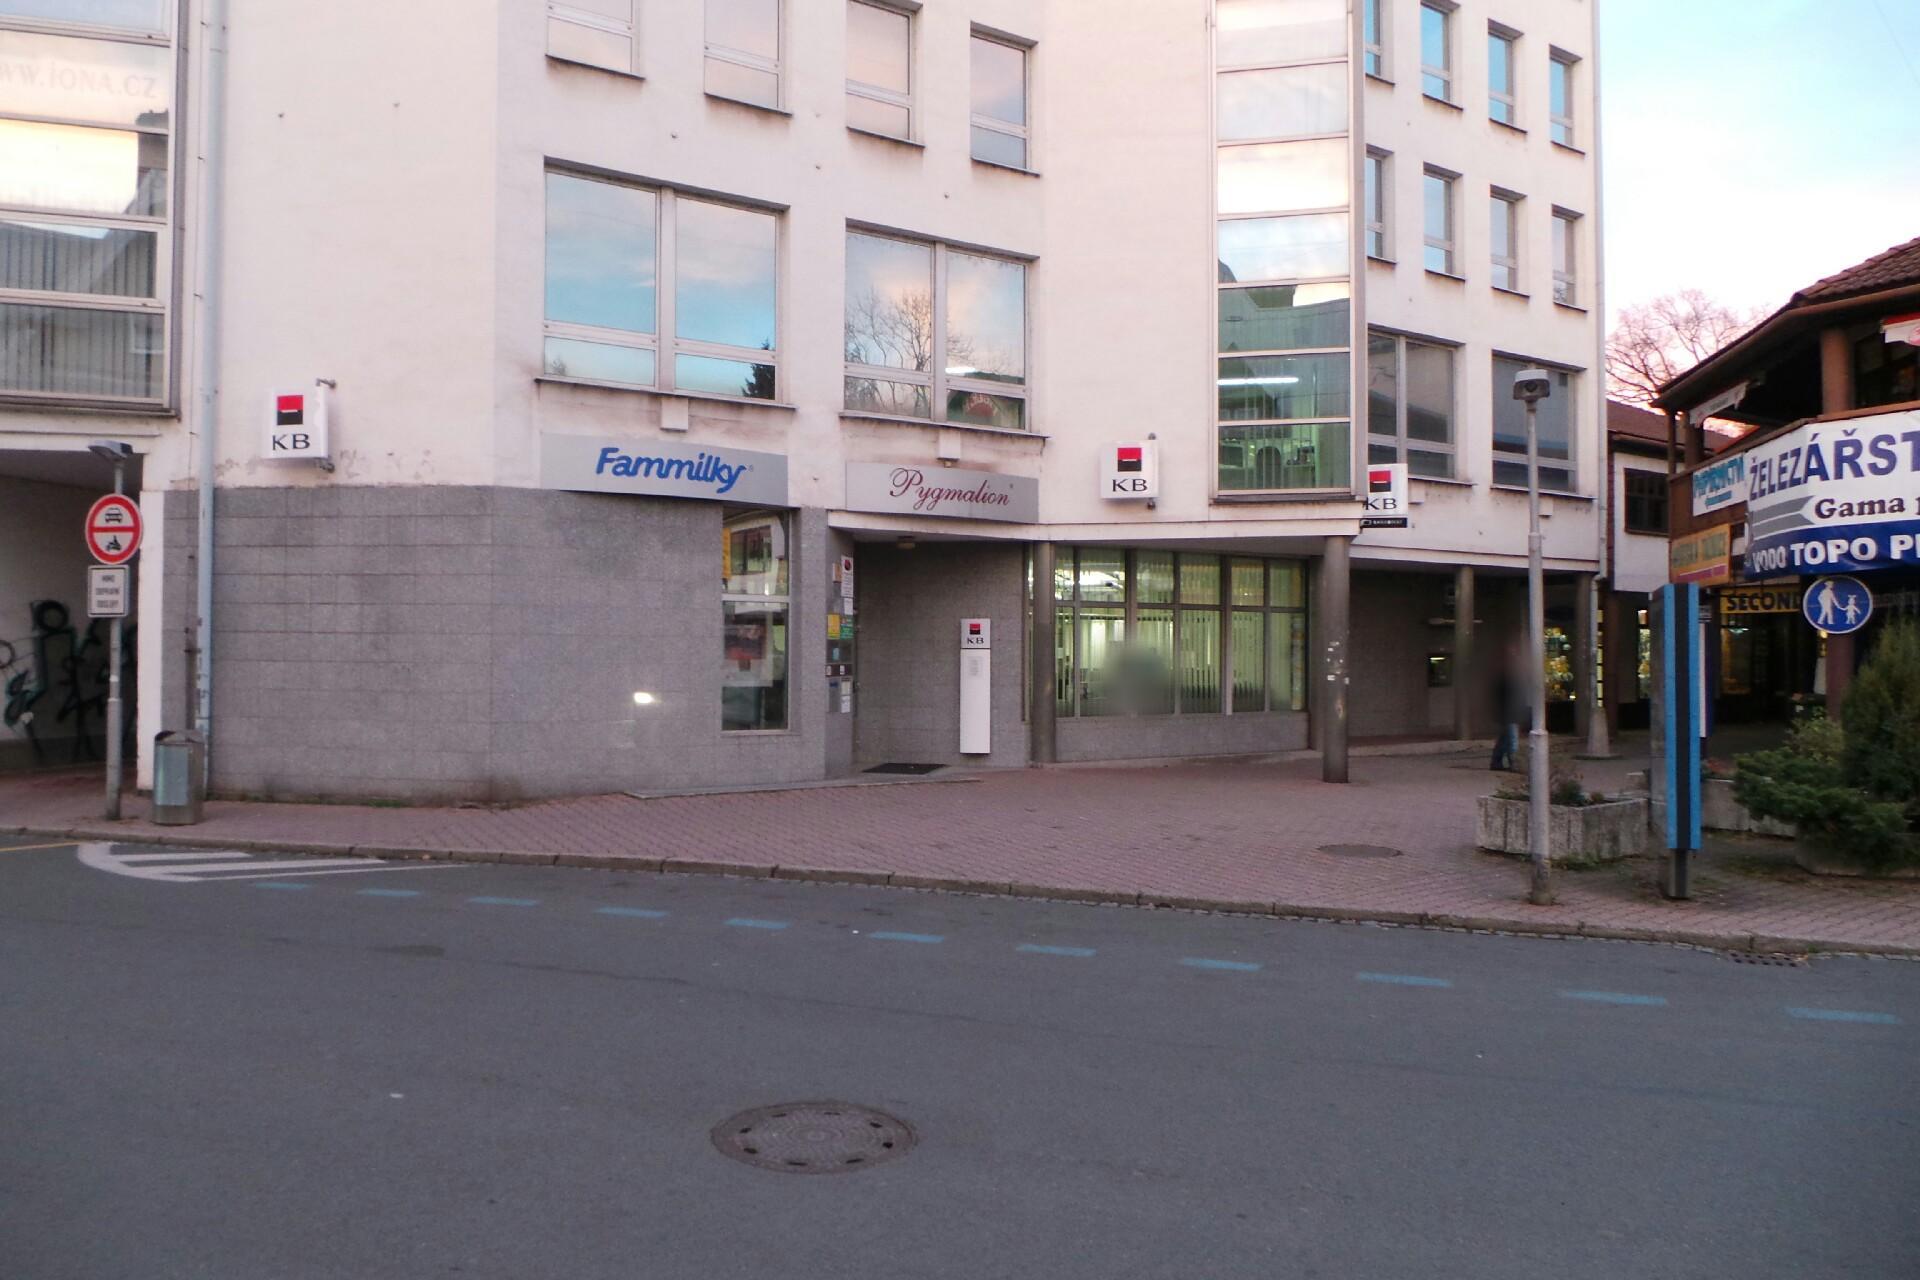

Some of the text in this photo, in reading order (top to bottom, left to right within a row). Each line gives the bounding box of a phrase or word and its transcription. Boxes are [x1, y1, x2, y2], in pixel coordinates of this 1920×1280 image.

[272, 433, 311, 451] KB
[596, 447, 747, 494] Fammilky
[889, 467, 1010, 511] Pygmalion
[1112, 478, 1148, 492] KB
[1365, 496, 1397, 511] KB
[1814, 497, 1906, 519] Gama
[1790, 536, 1878, 567] TOPO
[1890, 534, 1920, 560] P
[967, 637, 984, 645] KB
